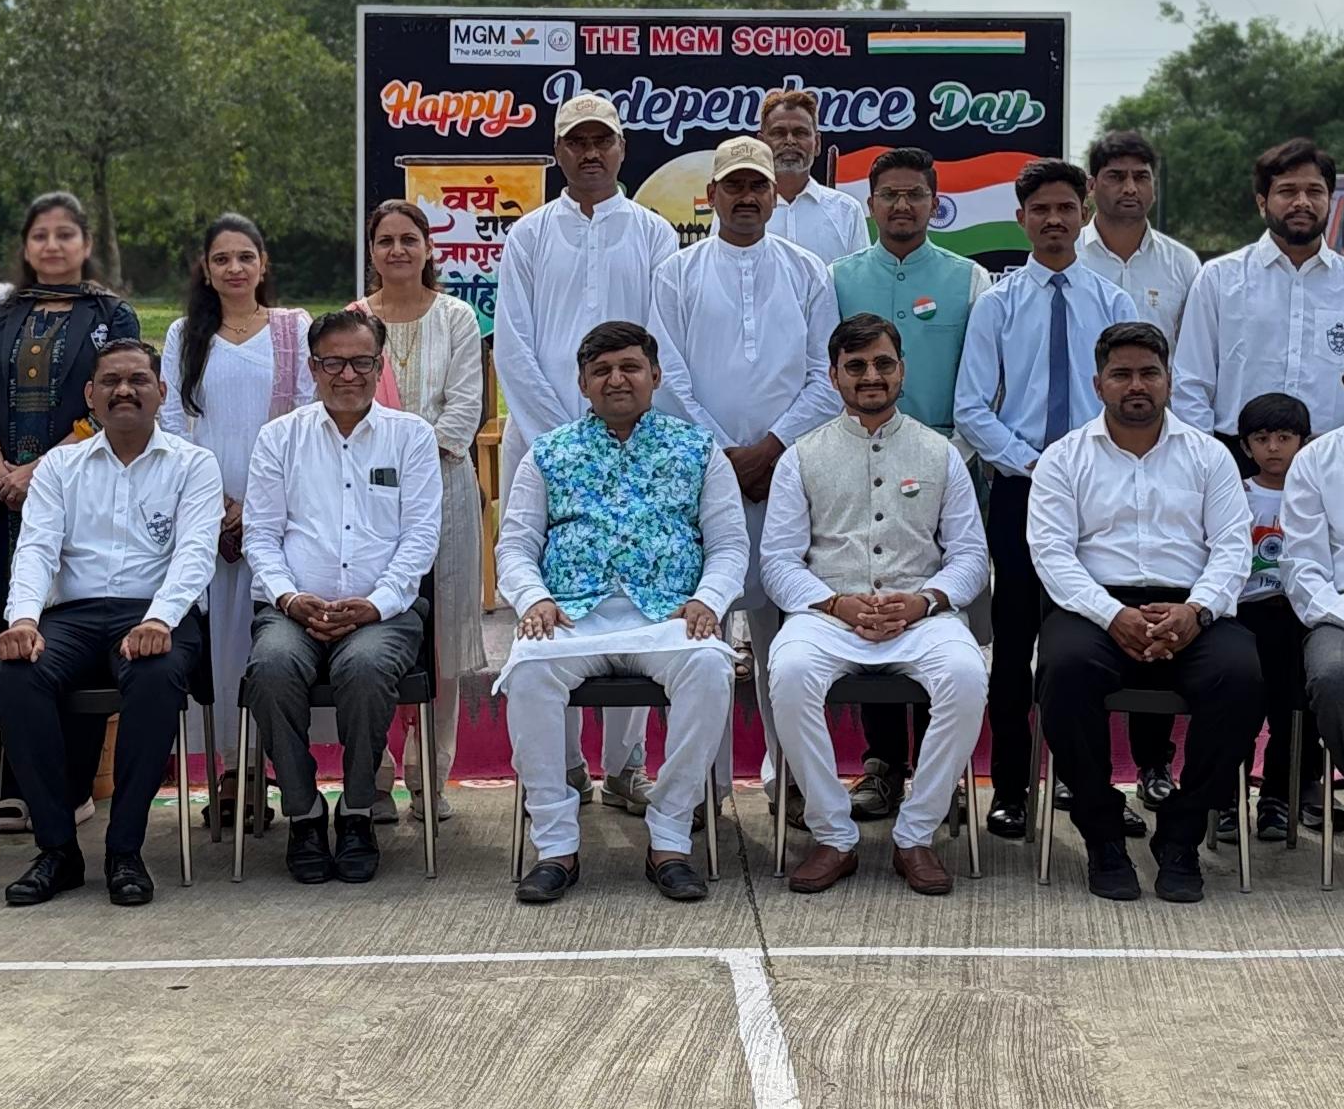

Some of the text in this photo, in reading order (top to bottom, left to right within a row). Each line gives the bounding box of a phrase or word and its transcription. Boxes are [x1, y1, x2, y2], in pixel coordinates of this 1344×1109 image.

[454, 25, 506, 44] MGM
[580, 25, 641, 55] THE
[650, 26, 723, 56] MGM
[732, 26, 851, 56] SCHOOL
[454, 48, 521, 58] The MGM School
[381, 79, 536, 137] Happy
[929, 81, 1046, 134] Day
[441, 175, 499, 213] वयं
